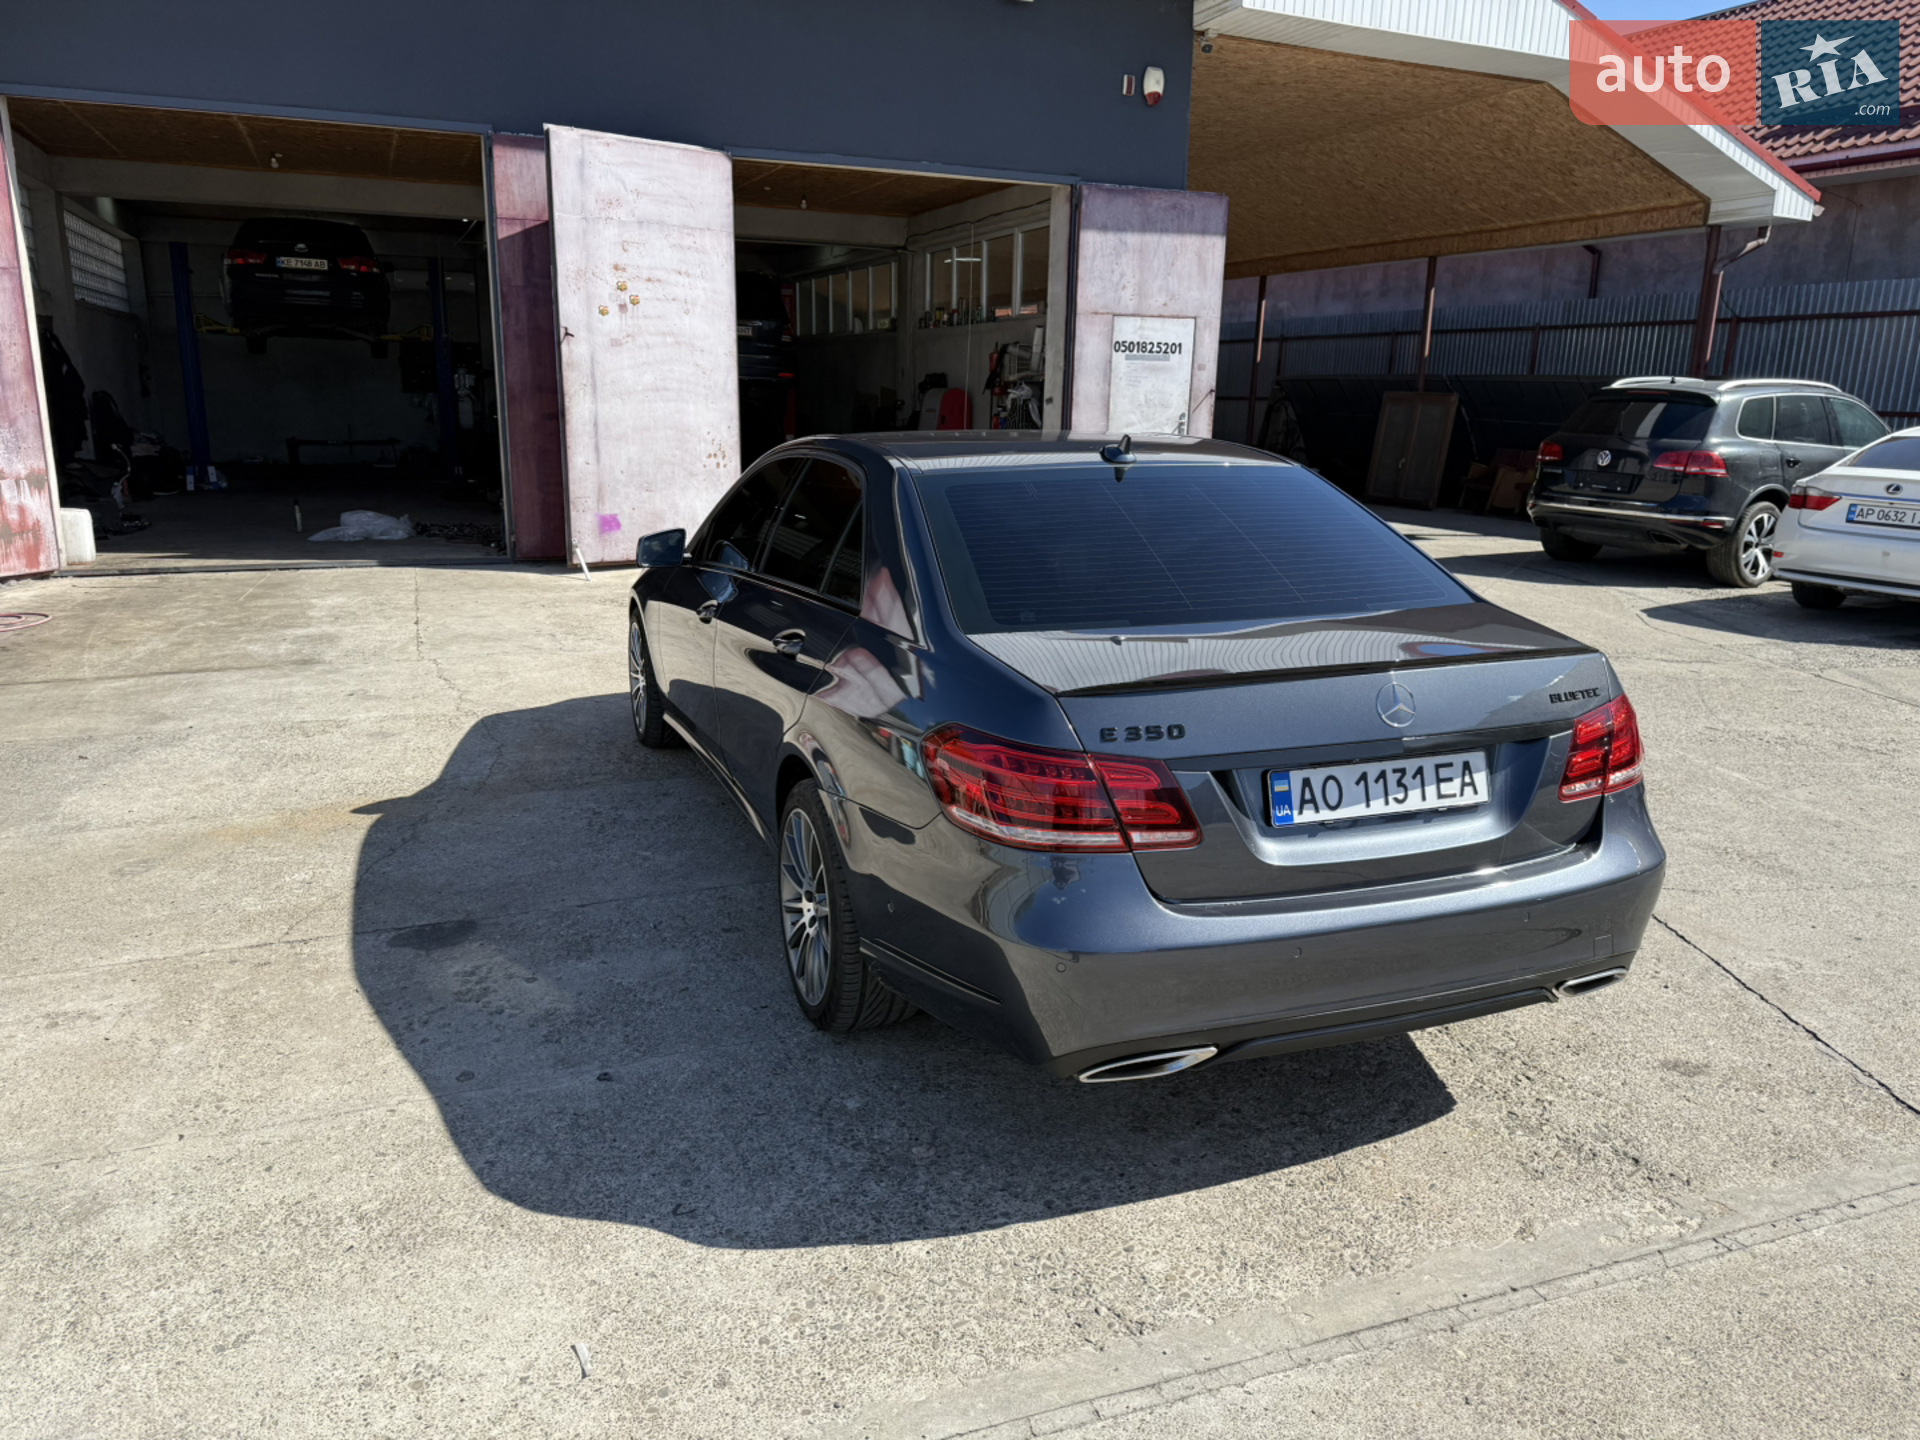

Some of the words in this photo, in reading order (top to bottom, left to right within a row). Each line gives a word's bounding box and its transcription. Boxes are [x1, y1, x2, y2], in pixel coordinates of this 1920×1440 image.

[1113, 340, 1182, 355] 0501825201
[1856, 507, 1875, 520] AP
[1877, 509, 1907, 524] 0632
[1549, 687, 1601, 704] BLUETEC
[1099, 727, 1119, 744] E
[1123, 724, 1187, 743] 350
[1297, 774, 1344, 816] AO
[1354, 765, 1427, 808] 1131
[1434, 760, 1479, 801] EA
[1275, 804, 1292, 816] UA
